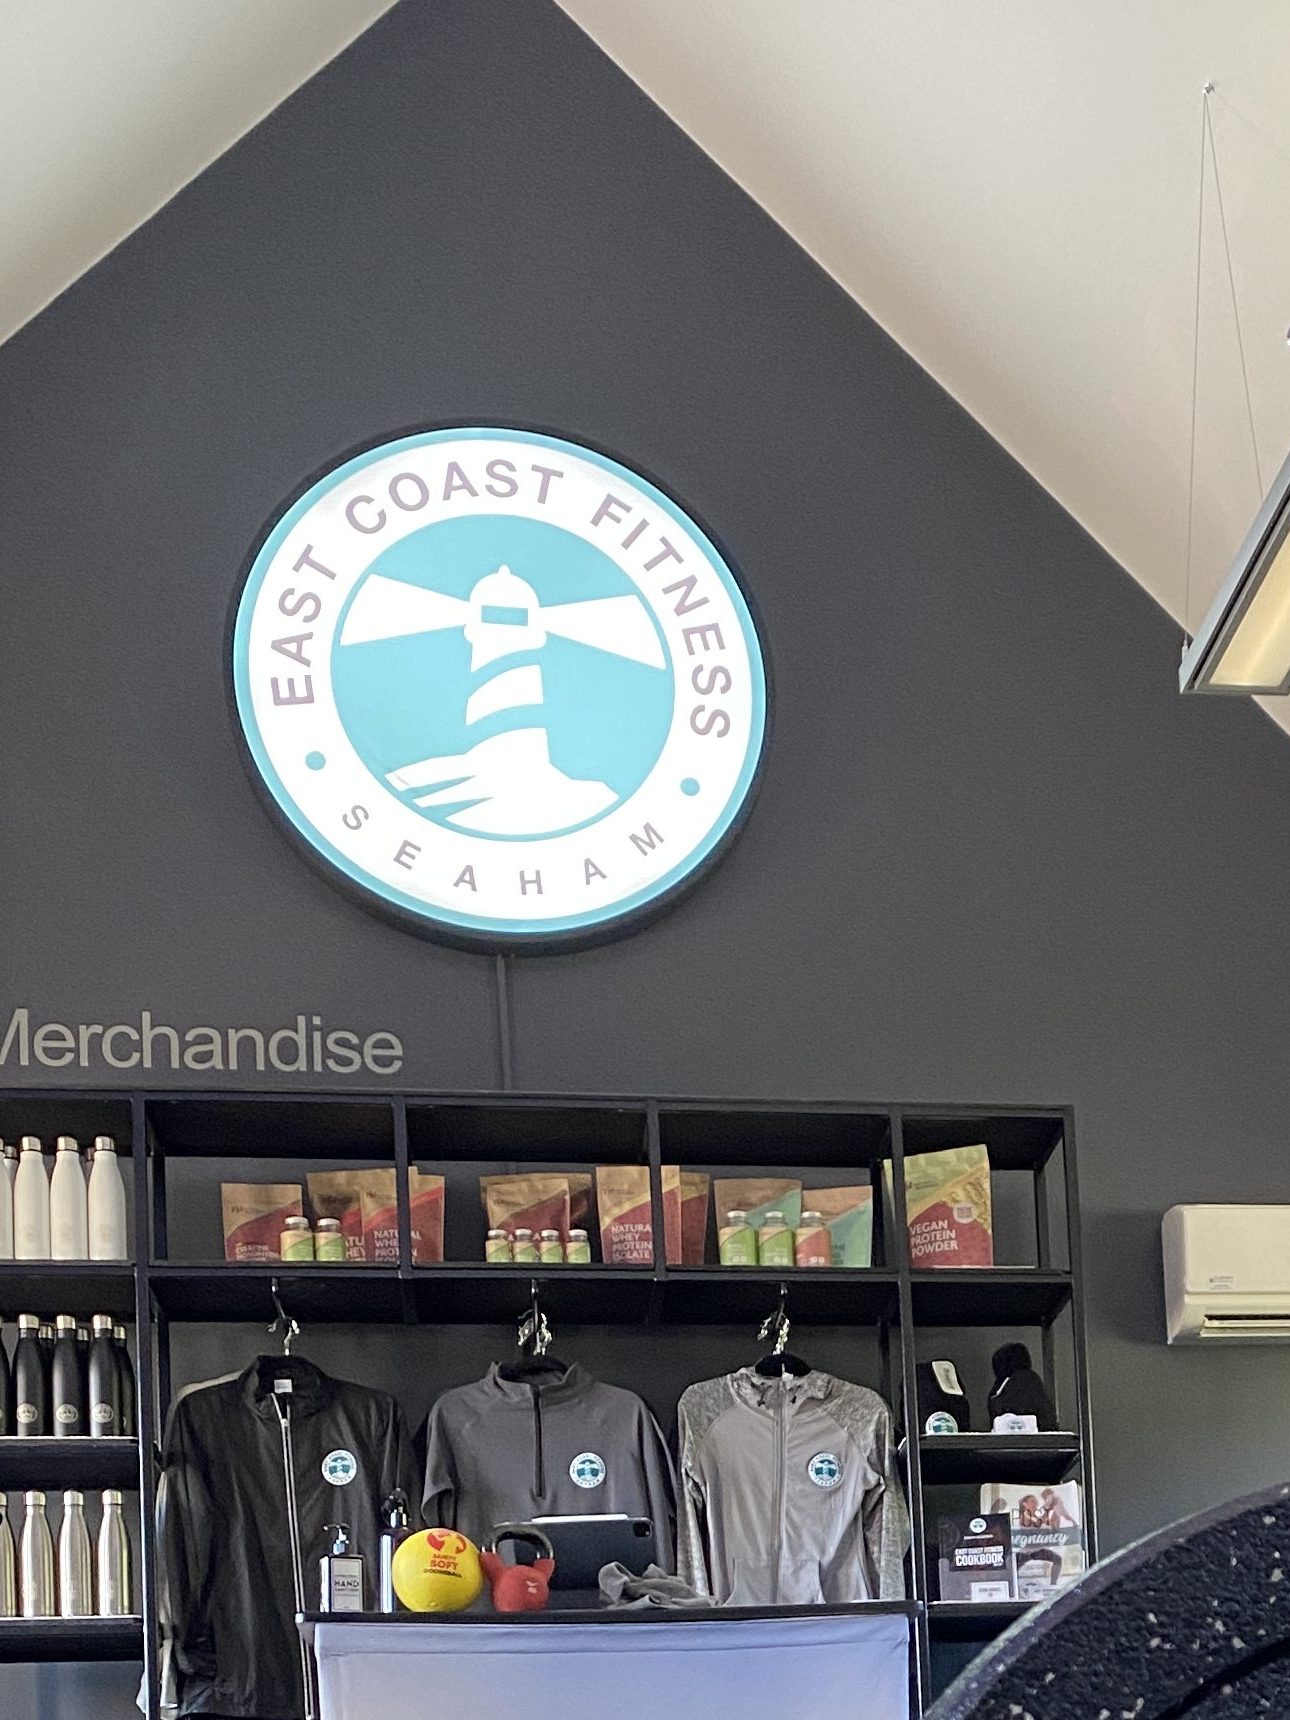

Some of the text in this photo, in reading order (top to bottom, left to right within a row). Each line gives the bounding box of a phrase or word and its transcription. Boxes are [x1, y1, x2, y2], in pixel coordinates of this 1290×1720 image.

[270, 459, 732, 739] EAST COAST FITNESS
[342, 804, 664, 895] SEAHAM
[611, 1223, 652, 1234] NATURA
[909, 1219, 948, 1235] VEGAN
[375, 1239, 400, 1247] WHE
[612, 1232, 640, 1243] WHEY
[910, 1229, 956, 1247] PROTEIN
[612, 1240, 652, 1251] PROTEIN
[911, 1240, 959, 1259] POWDER
[430, 1560, 458, 1570] SOFT
[955, 1552, 1004, 1567] COOKBOOK
[334, 1579, 359, 1587] HAND
